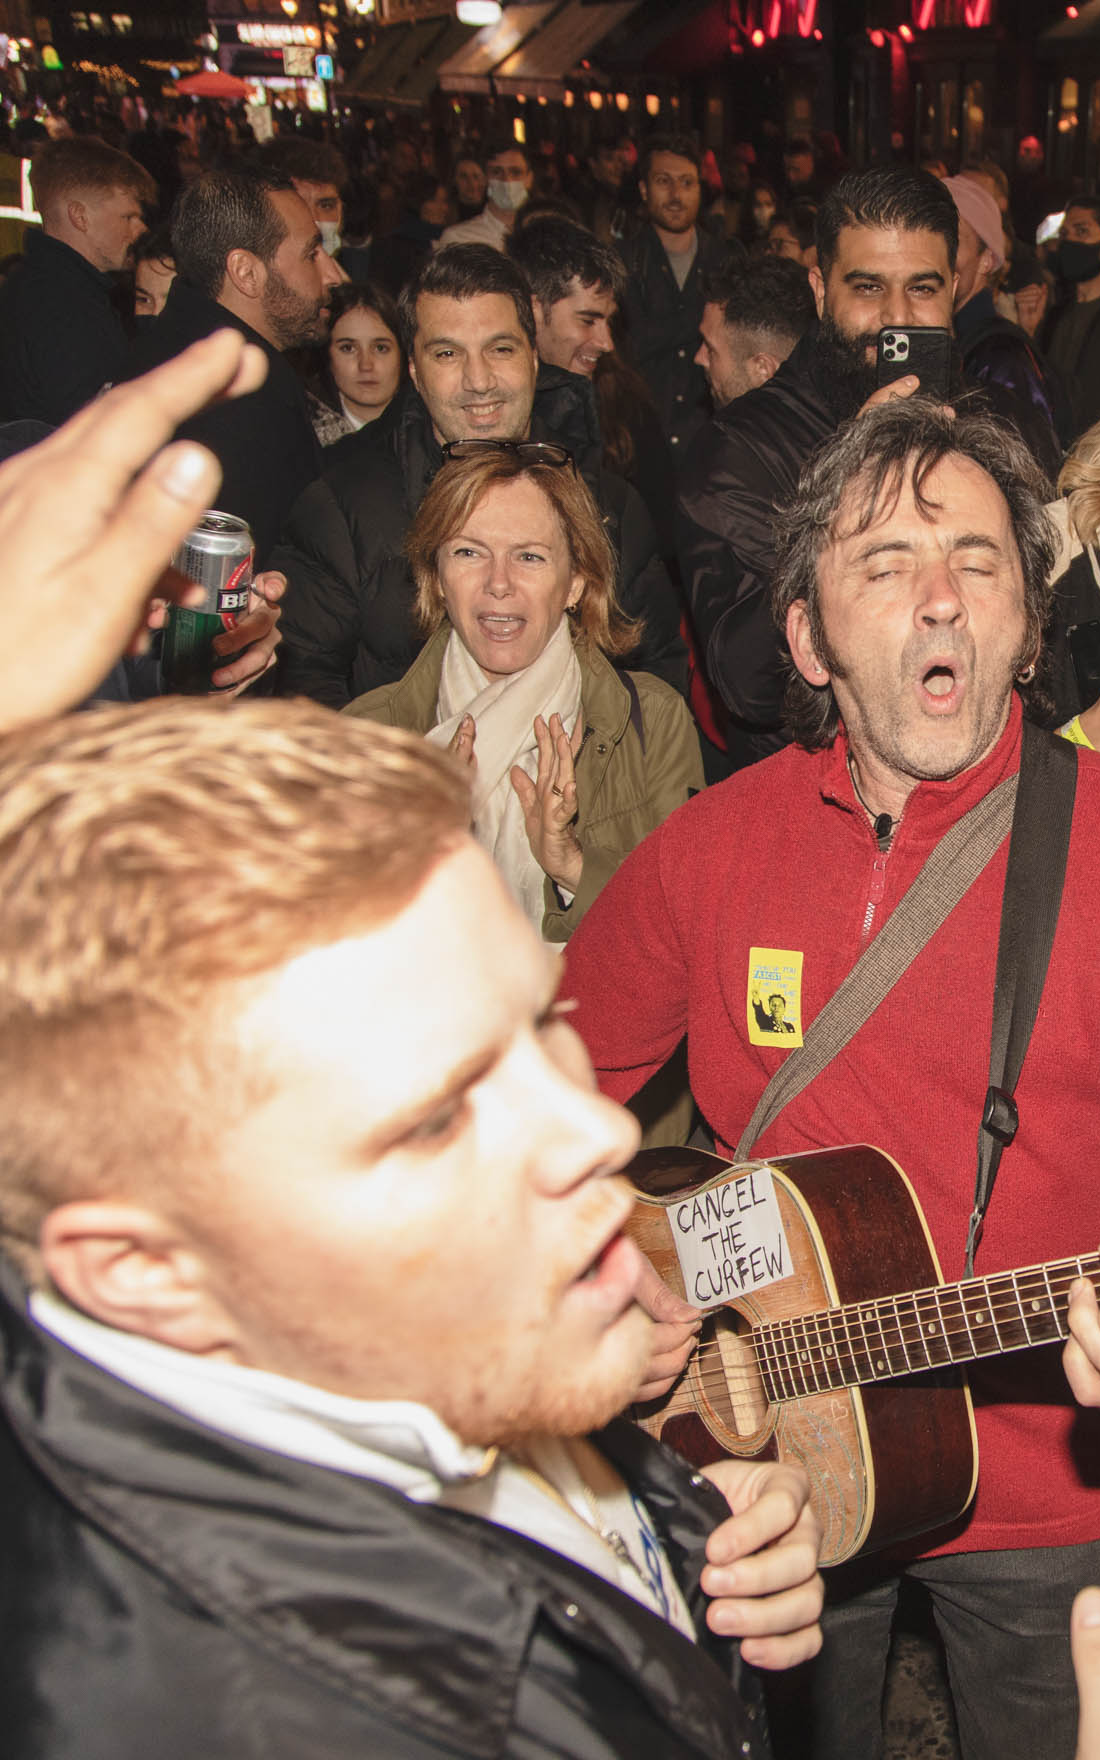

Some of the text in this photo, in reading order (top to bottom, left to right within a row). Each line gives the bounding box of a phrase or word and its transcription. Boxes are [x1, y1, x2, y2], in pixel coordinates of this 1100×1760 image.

[677, 1175, 766, 1233] CANCEL
[695, 1233, 784, 1301] CURFEW
[702, 1221, 746, 1260] THE
